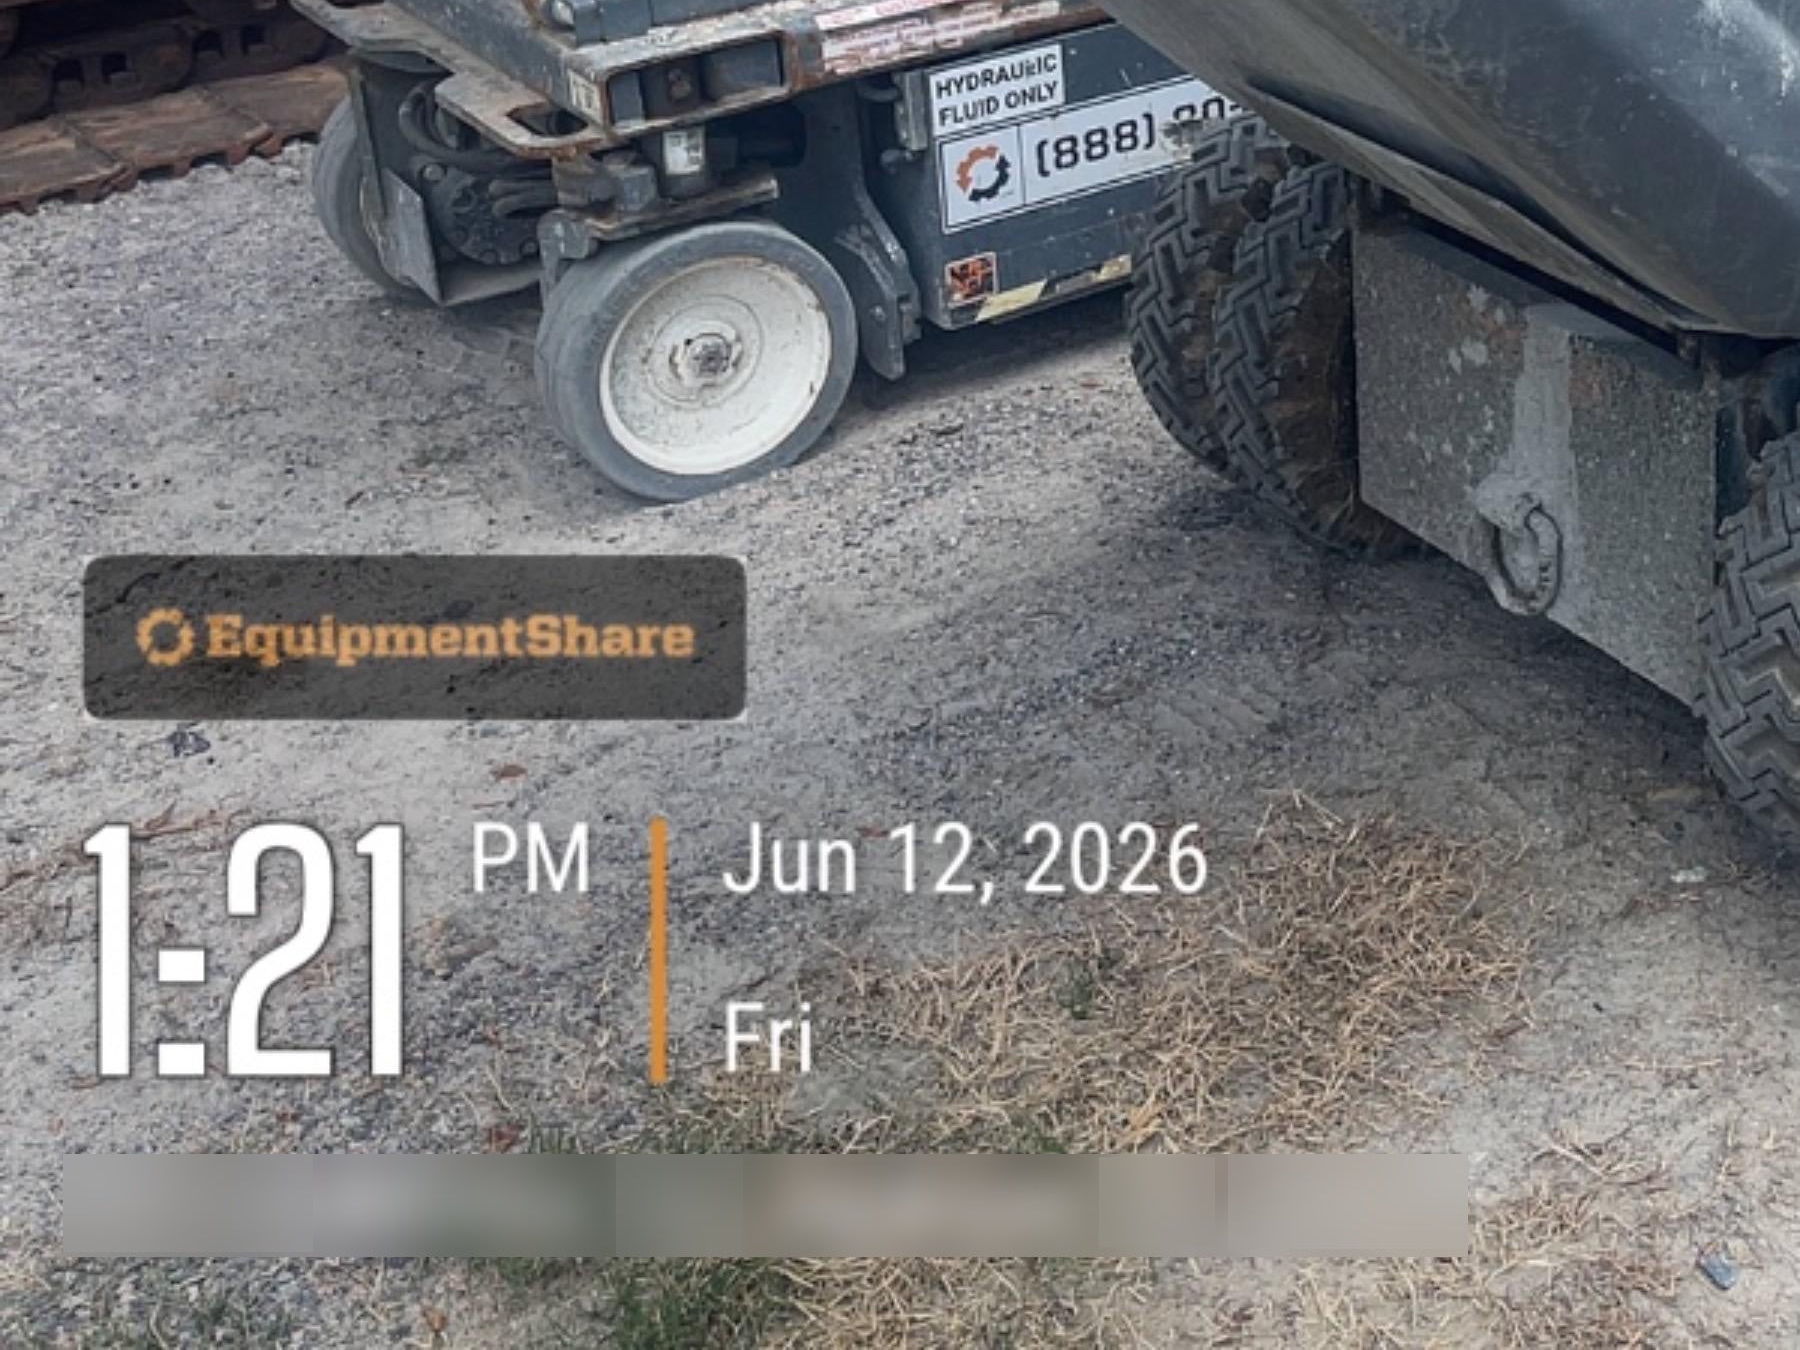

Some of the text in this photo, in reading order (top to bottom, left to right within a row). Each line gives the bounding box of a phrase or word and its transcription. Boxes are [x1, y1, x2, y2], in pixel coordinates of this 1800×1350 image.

[938, 80, 1058, 127] FLUID ONLY
[1036, 113, 1156, 178] (888)
